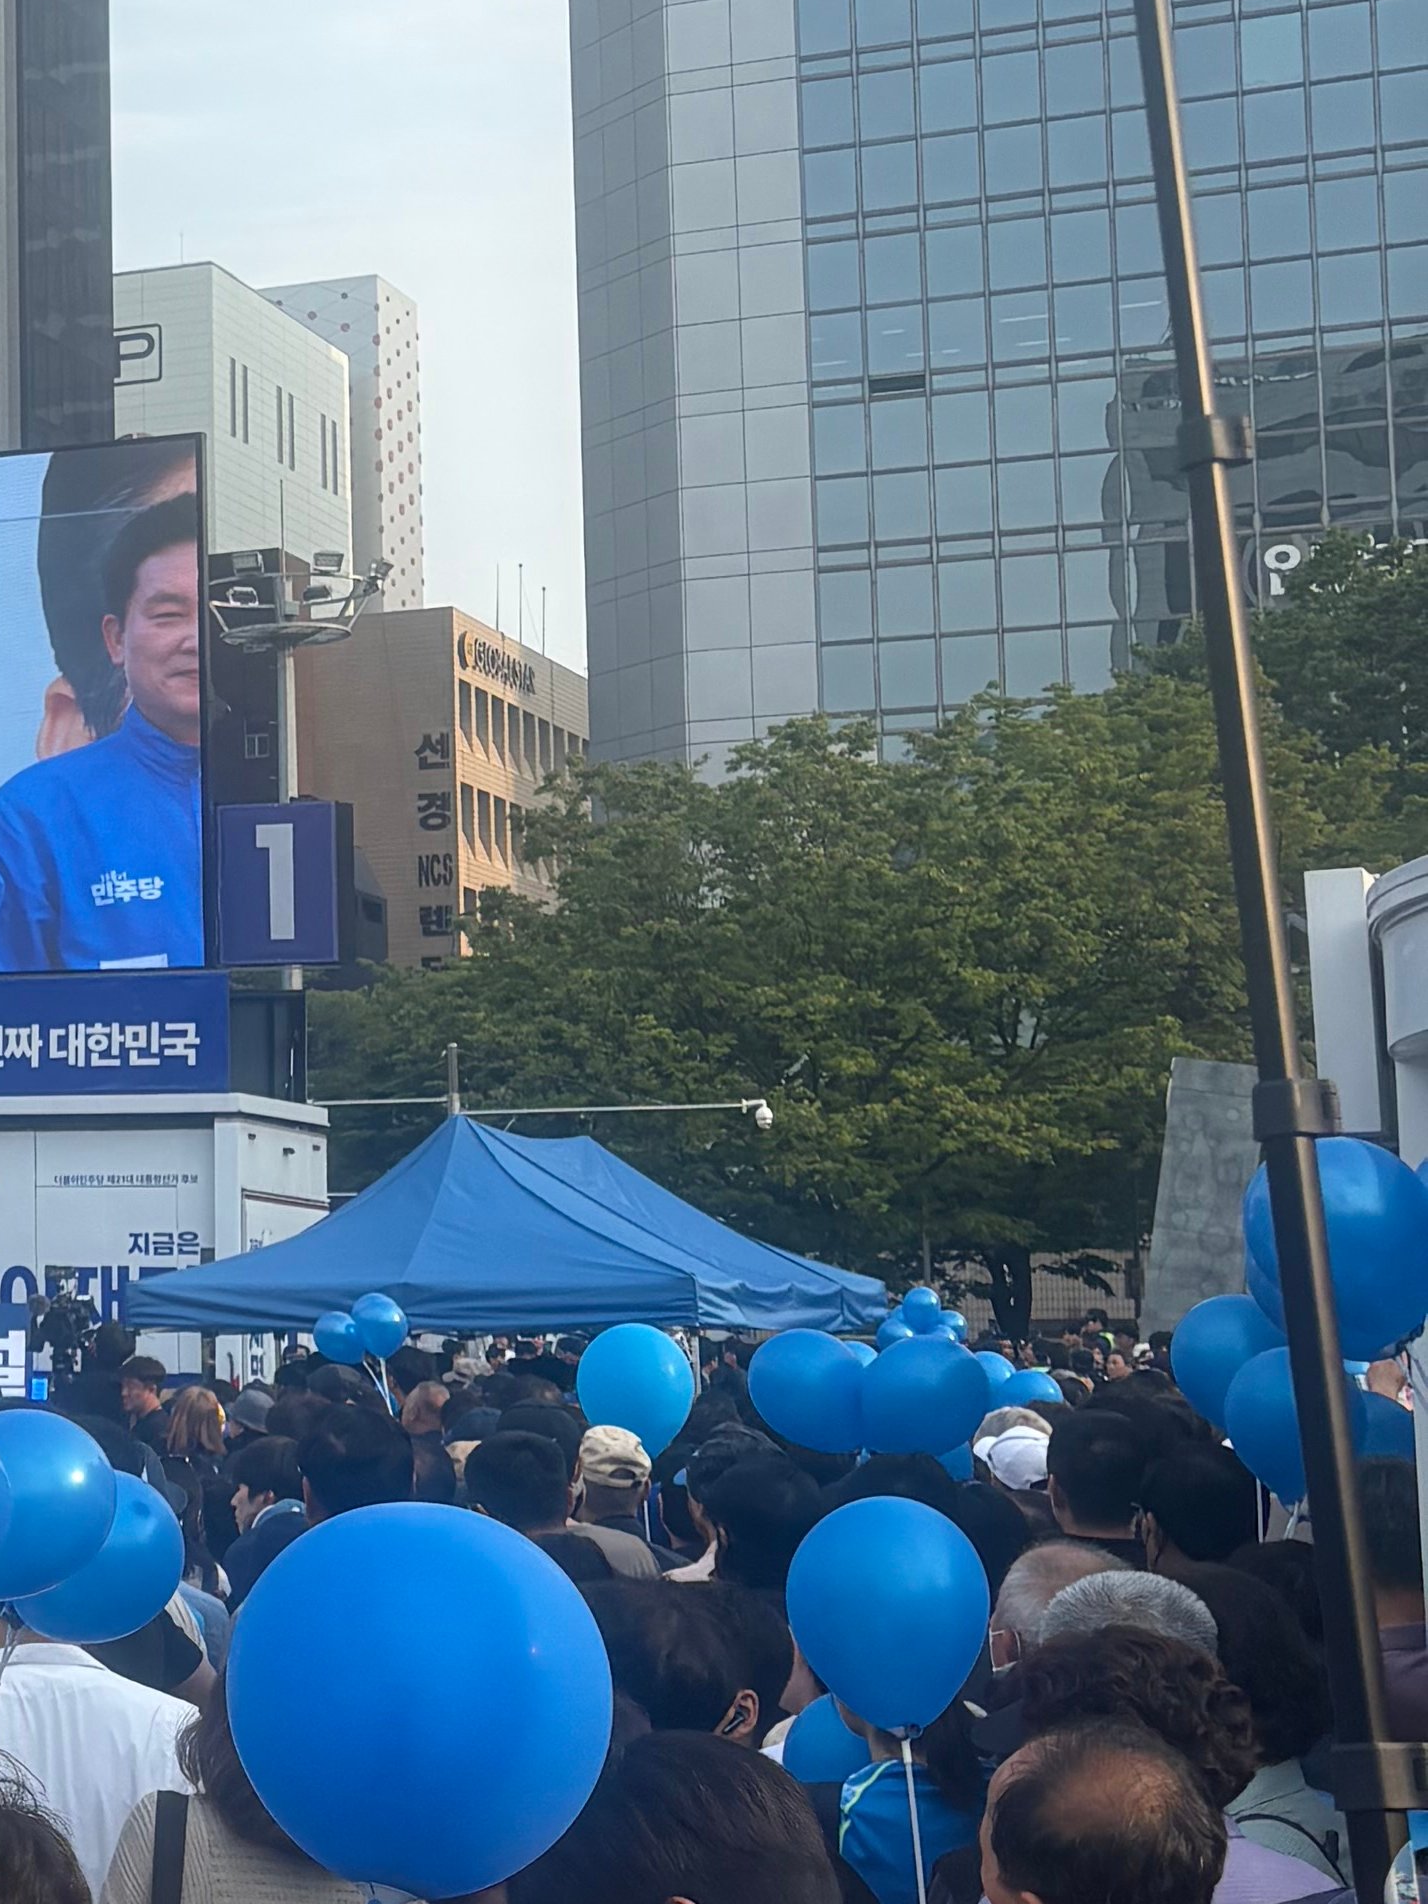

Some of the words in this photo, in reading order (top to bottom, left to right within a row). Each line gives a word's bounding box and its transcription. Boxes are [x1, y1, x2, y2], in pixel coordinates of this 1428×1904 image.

[255, 823, 295, 941] 1
[418, 853, 453, 888] NCS
[91, 876, 164, 907] 민주당
[48, 1022, 201, 1068] 대한민국
[128, 1231, 200, 1256] 지금은
